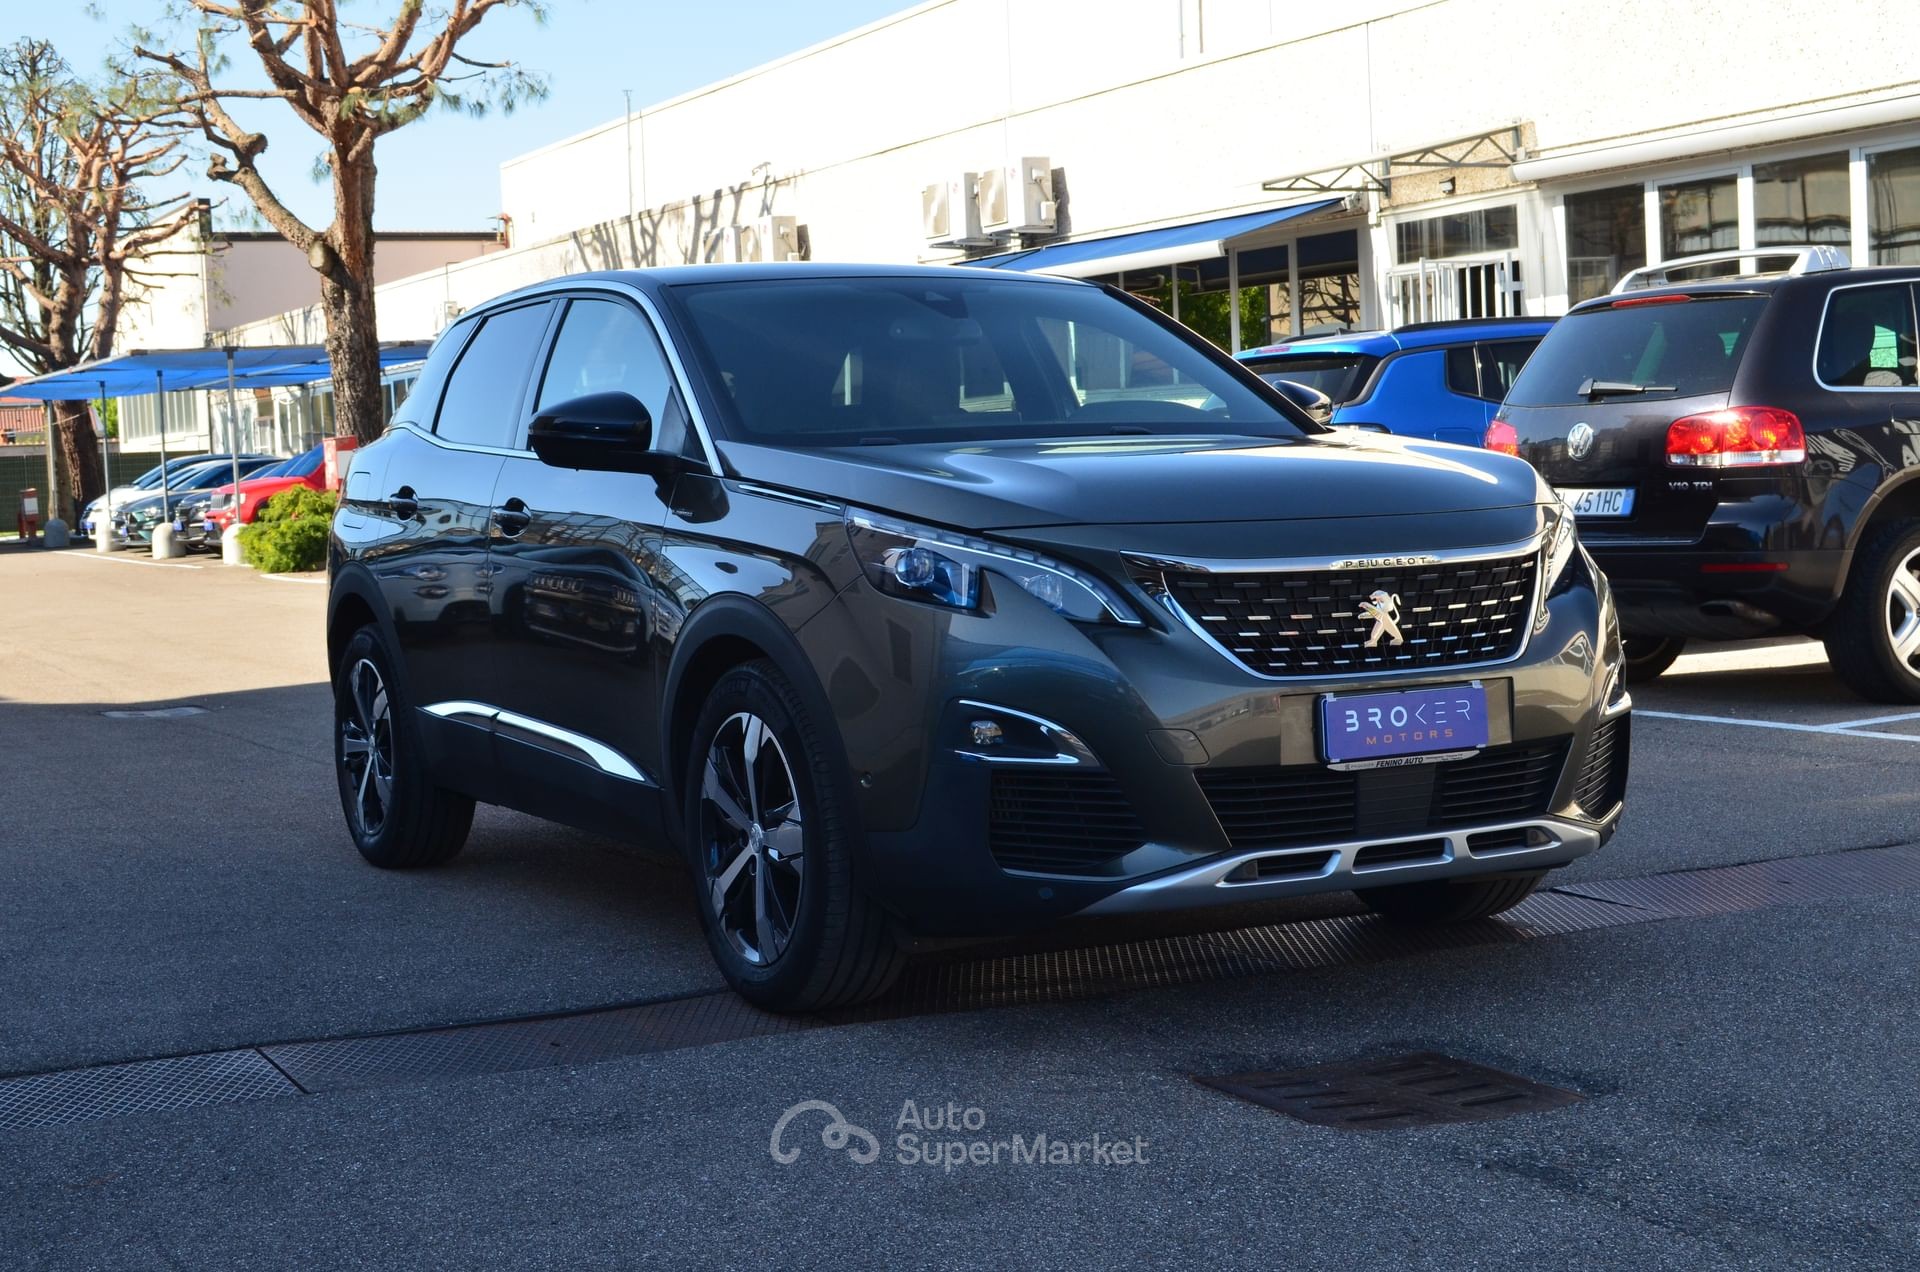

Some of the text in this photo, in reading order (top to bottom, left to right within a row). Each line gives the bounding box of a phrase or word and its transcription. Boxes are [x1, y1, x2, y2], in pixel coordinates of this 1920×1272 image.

[1692, 481, 1713, 490] TDI
[1574, 491, 1623, 513] 451HC
[1345, 557, 1427, 568] PEUGEOT
[1345, 699, 1471, 732] BROKER
[1366, 728, 1454, 745] MOTORS
[1375, 758, 1403, 768] FENINO
[1404, 756, 1424, 766] AUTO
